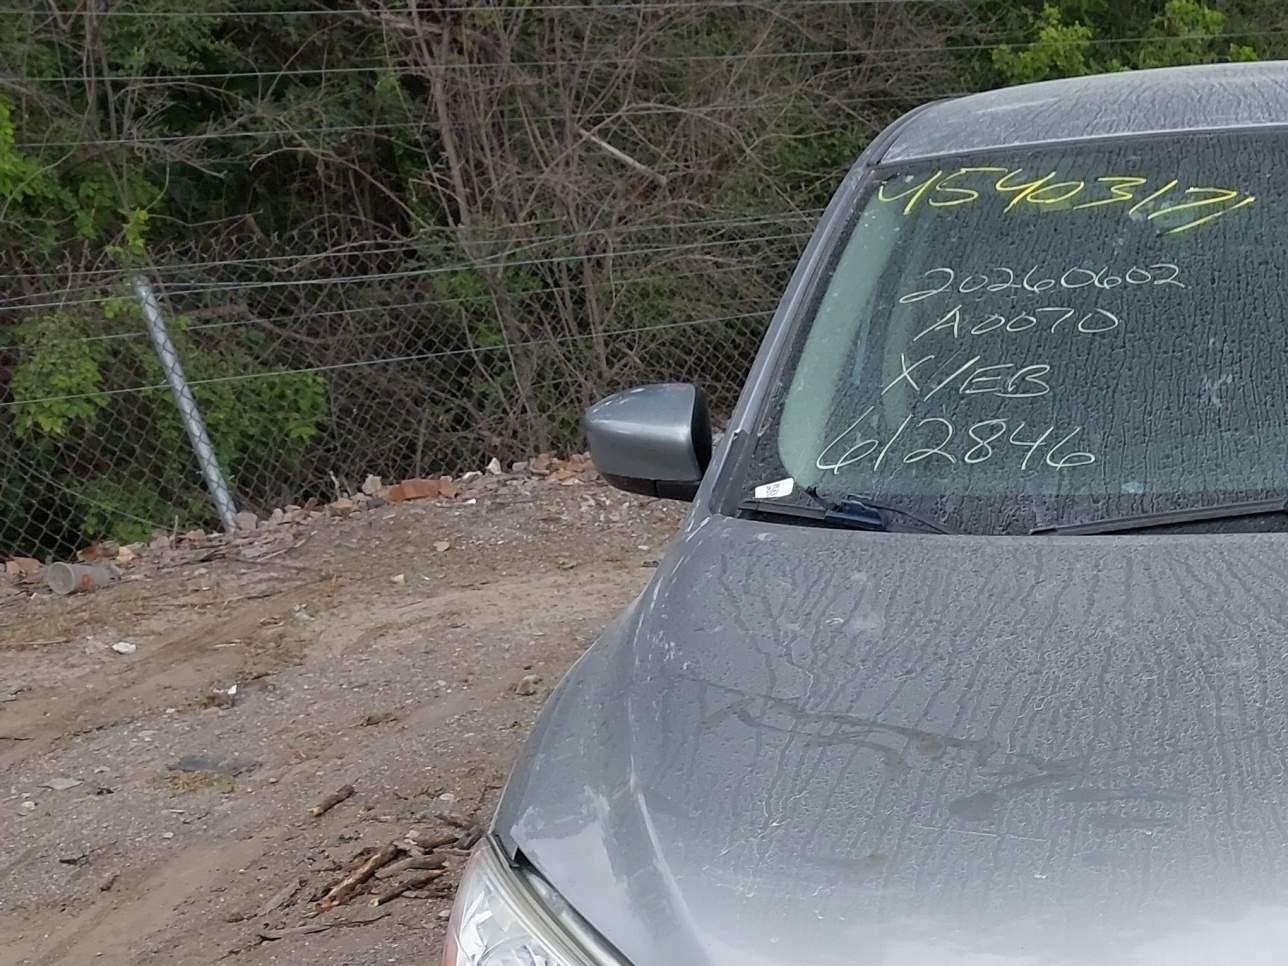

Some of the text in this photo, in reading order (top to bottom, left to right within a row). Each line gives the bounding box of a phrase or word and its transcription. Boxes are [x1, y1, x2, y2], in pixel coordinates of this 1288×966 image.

[899, 264, 1187, 303] 20260602
[913, 305, 1119, 342] A0070
[815, 406, 1096, 475] 612846
